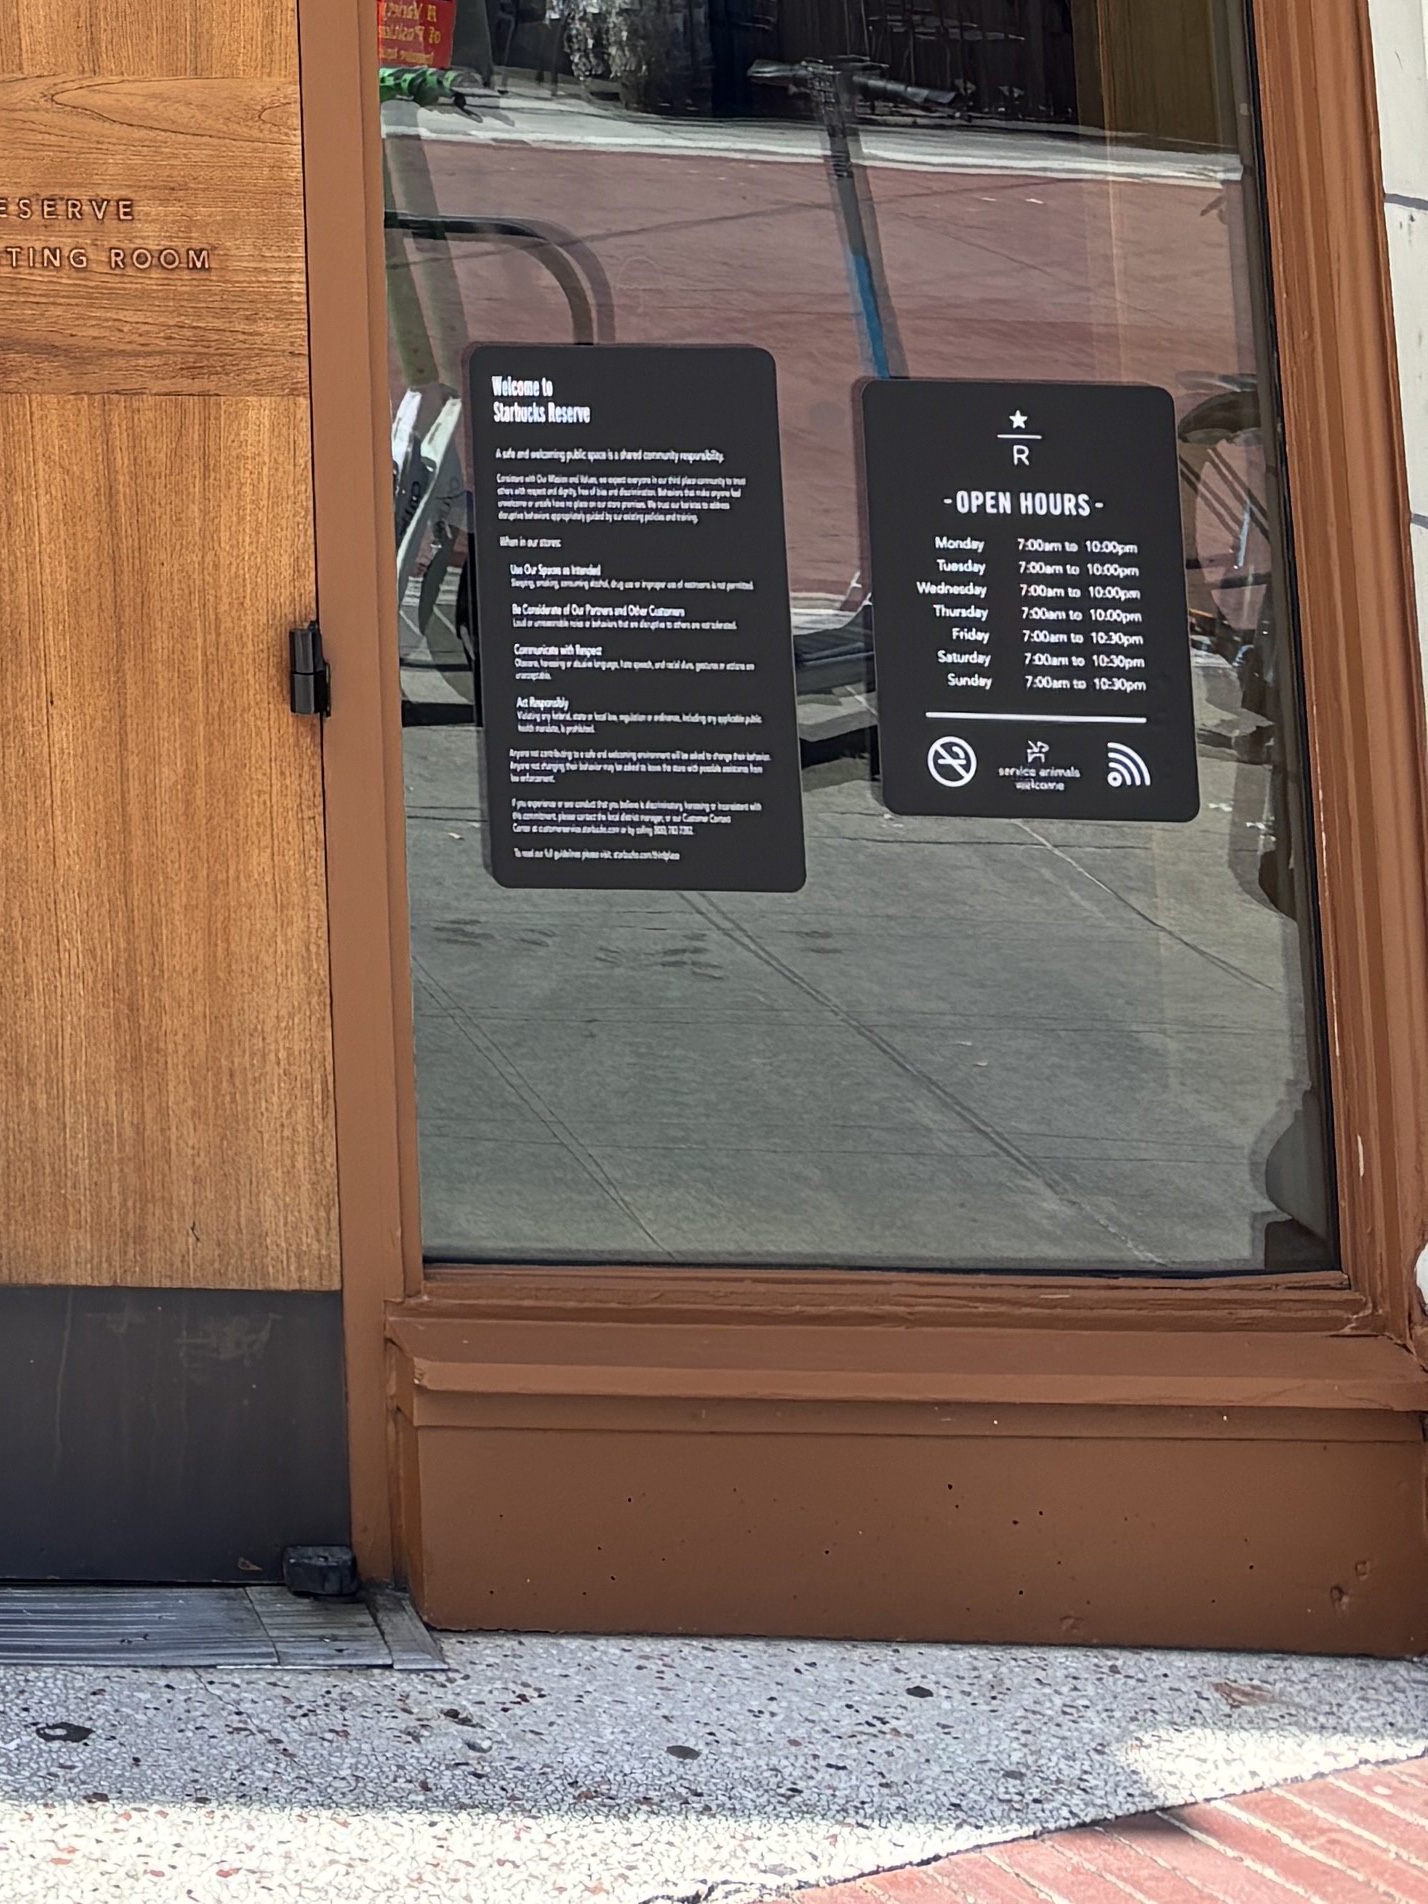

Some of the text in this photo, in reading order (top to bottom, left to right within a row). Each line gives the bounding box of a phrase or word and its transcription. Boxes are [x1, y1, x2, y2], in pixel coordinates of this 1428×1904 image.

[110, 248, 212, 271] ROOM
[492, 376, 553, 397] Welcome to
[494, 402, 591, 424] Starbucks Reserve
[1013, 445, 1029, 465] R
[935, 537, 1138, 555] Monday 7:00am to 10:00pm
[937, 559, 1139, 578] Tuesday 7:00am to 10:00pm
[916, 582, 1141, 601] Wednesday 7:00am to 10:00pm
[933, 604, 1142, 623] Thursday 7:00am to 10:00pm
[952, 628, 1143, 646] Friday 7:00am to 10:30pm
[938, 651, 1145, 670] Saturday 7:00am to 10:30pm
[948, 674, 1146, 693] Sunday 7:00am to 10:30pm
[998, 767, 1080, 778] service animals
[1015, 780, 1064, 791] welcome
